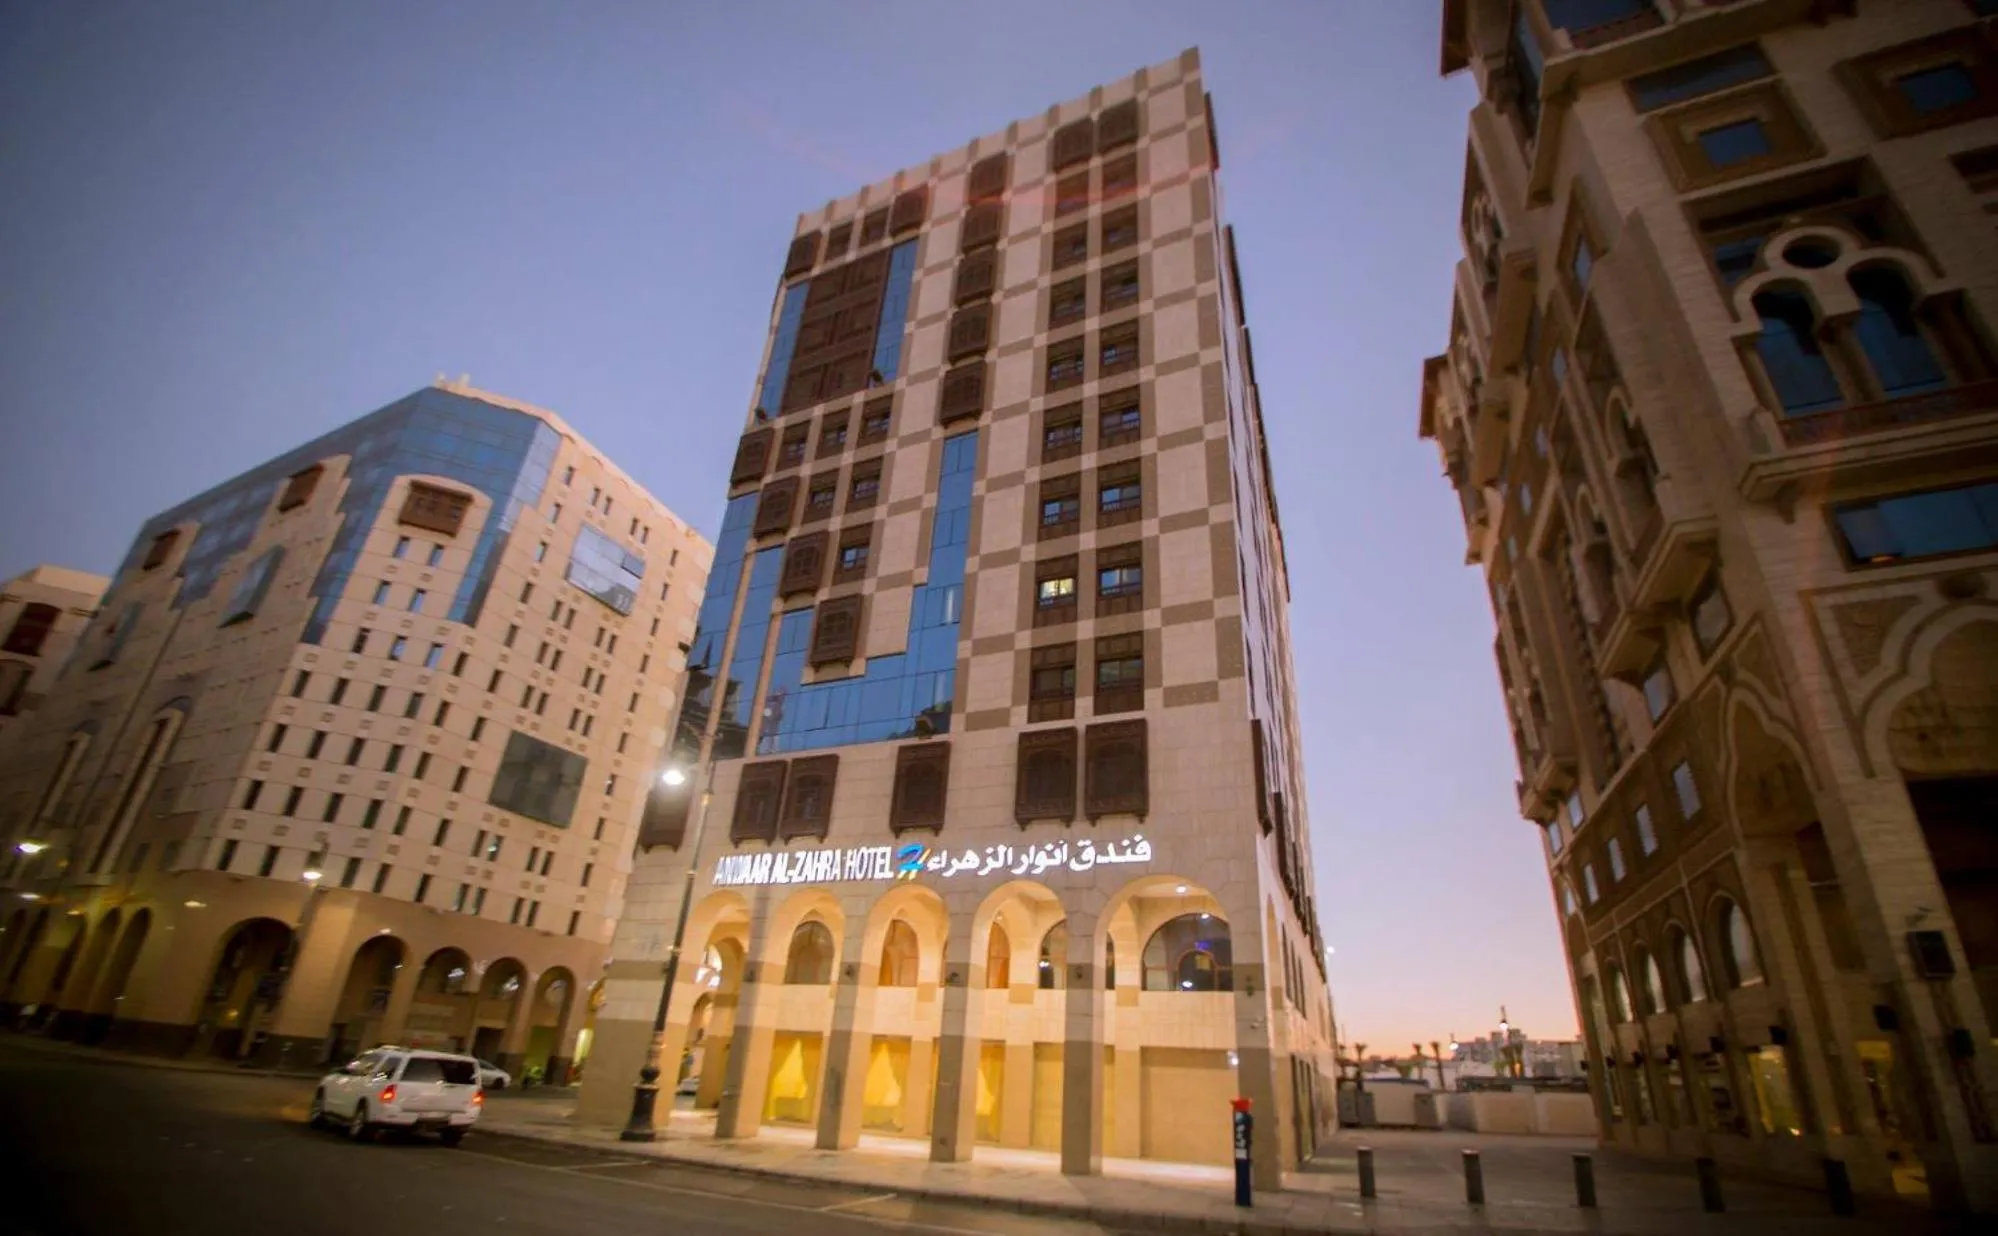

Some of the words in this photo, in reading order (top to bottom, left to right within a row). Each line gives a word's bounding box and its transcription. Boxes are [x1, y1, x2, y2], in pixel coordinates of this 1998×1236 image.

[770, 848, 842, 884] AL-ZAHRA
[844, 846, 894, 880] HOTEL
[927, 843, 1013, 877] الزهراء
[1069, 833, 1152, 871] فندق
